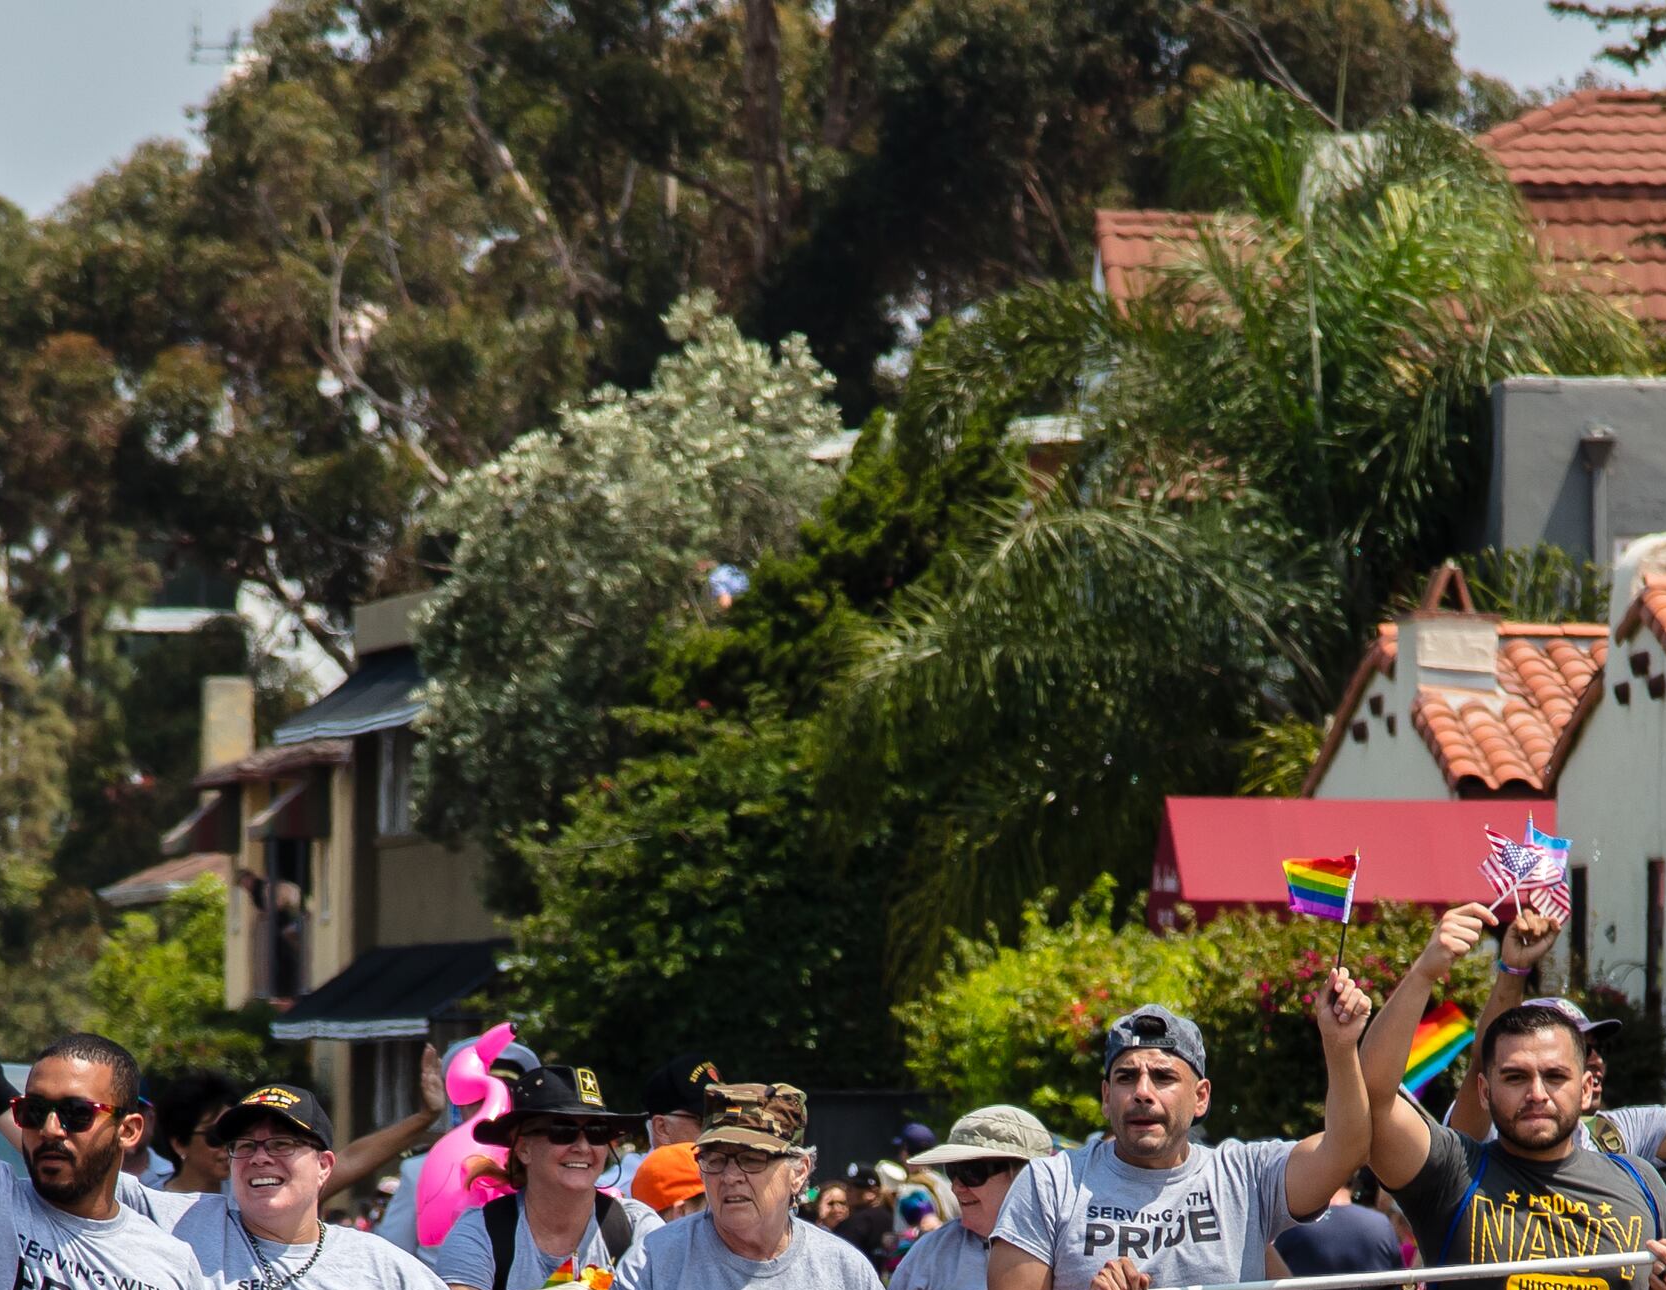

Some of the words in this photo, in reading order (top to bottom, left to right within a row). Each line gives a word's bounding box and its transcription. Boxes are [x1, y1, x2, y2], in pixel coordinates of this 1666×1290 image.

[1086, 1205, 1174, 1225] SERVING
[1528, 1193, 1591, 1217] PROUD
[18, 1233, 106, 1287] SERVING
[1084, 1210, 1222, 1260] PRIDE
[1470, 1193, 1643, 1281] NAVY
